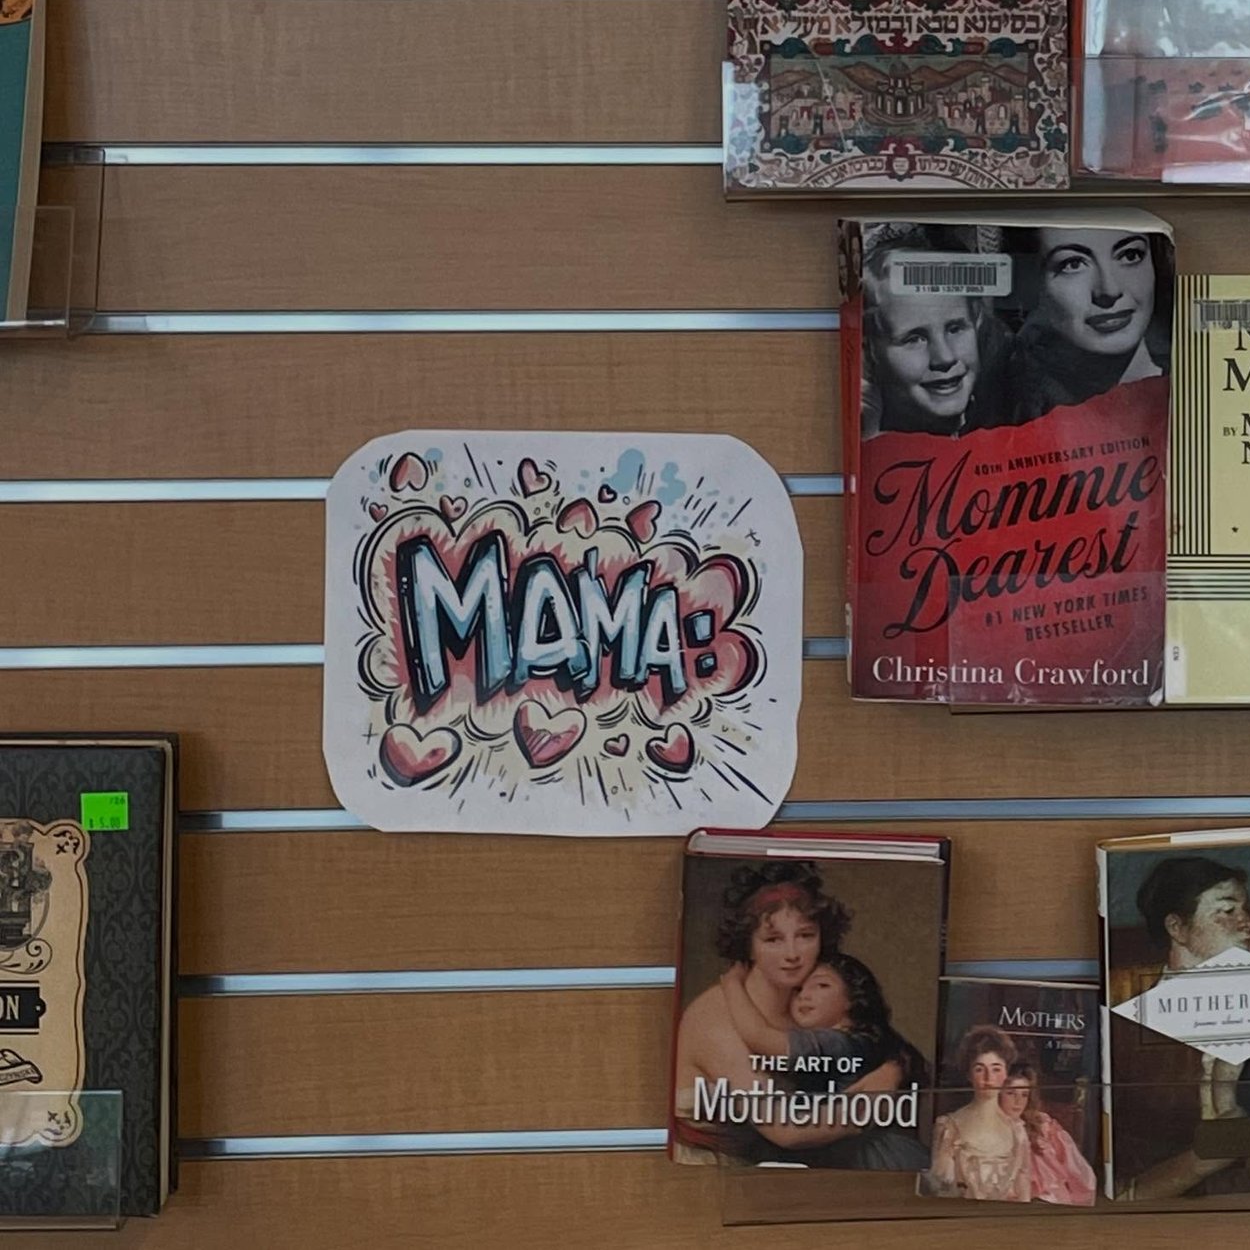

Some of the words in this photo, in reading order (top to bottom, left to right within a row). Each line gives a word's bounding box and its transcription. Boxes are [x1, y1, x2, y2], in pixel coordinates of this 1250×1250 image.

[1223, 426, 1237, 437] BY
[1008, 446, 1095, 471] ANNIVERSARY
[1100, 437, 1151, 456] EDITION
[866, 450, 1162, 557] Mommie
[883, 511, 1141, 640] Dearest
[1012, 603, 1046, 623] NEW
[1053, 596, 1096, 616] YORK
[1103, 586, 1149, 608] TIMES
[1025, 613, 1115, 643] BESTSELLER
[872, 656, 1003, 684] Christina
[1015, 658, 1150, 686] Crawford
[749, 1055, 789, 1072] THE
[794, 1056, 833, 1073] ART
[837, 1057, 864, 1073] OF
[693, 1076, 918, 1127] Motherhood
